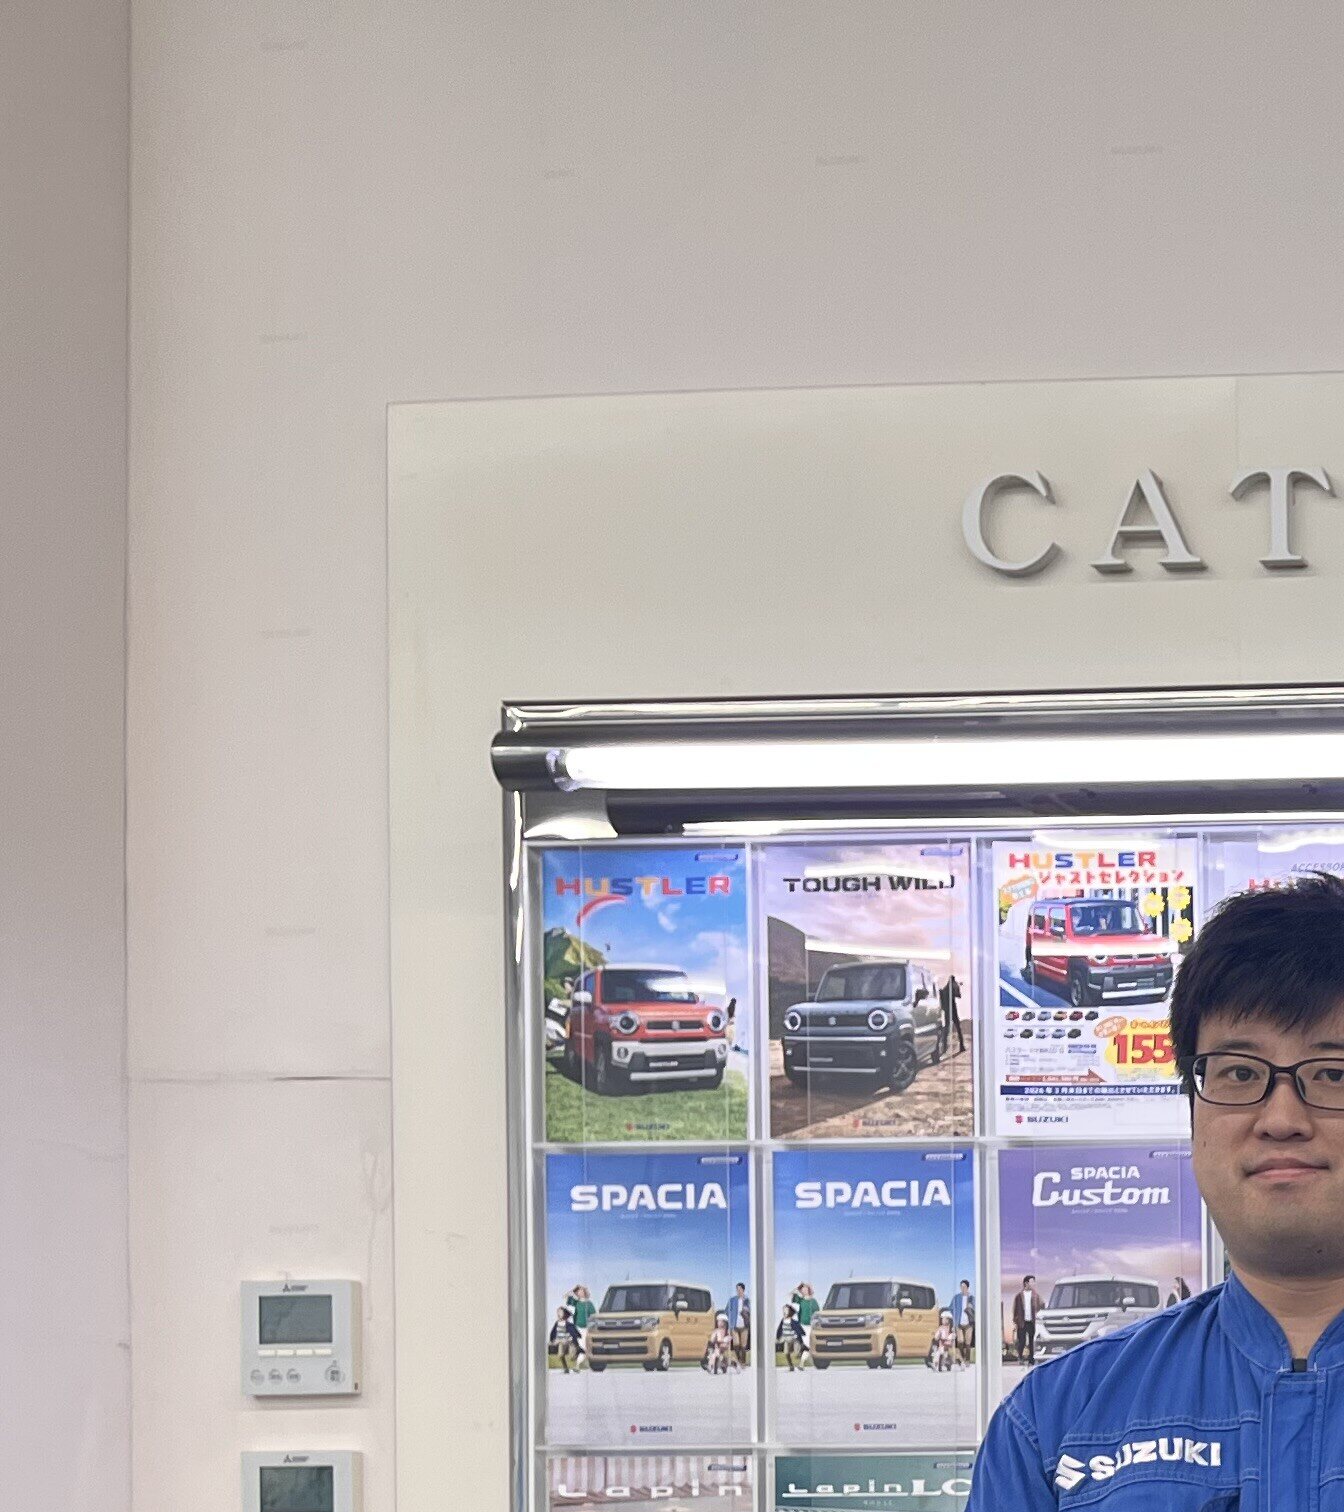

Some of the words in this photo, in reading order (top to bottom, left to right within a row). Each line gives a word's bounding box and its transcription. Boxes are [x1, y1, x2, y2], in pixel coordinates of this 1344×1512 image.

[1009, 851, 1157, 869] HUSTLER
[555, 874, 731, 897] HUSTLER
[783, 874, 885, 894] TOUGH
[1039, 869, 1185, 885] ジャストセレクション
[1070, 1165, 1141, 1180] SPACIA
[570, 1182, 727, 1212] SPACIA
[795, 1179, 951, 1209] SPACIA
[1032, 1171, 1171, 1207] Custom
[1090, 1440, 1221, 1481] SUZUKI
